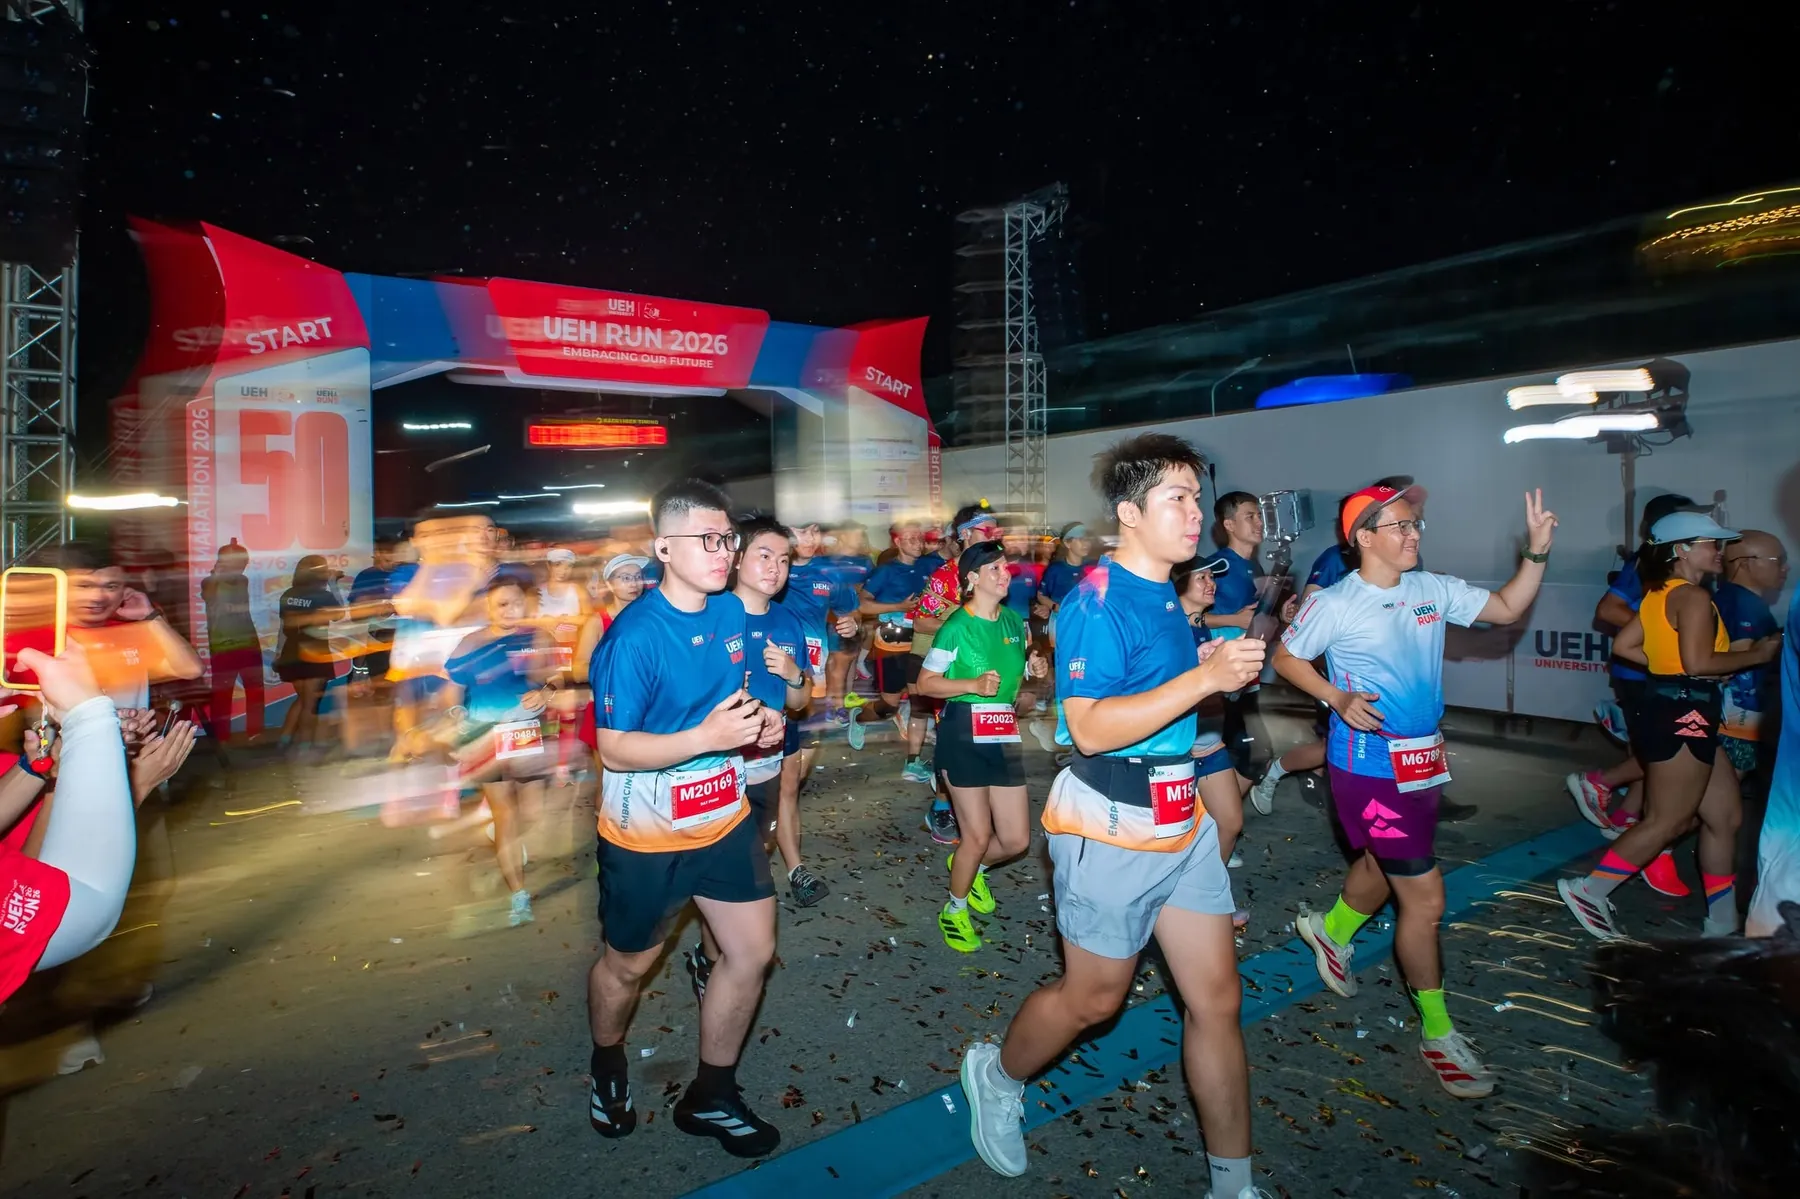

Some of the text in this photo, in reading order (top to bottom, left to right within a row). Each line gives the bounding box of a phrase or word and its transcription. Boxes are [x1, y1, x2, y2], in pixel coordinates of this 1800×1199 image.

[608, 298, 634, 312] UEH
[245, 316, 332, 354] START
[543, 315, 597, 344] UEH
[606, 322, 663, 349] RUN
[669, 329, 729, 356] 2026
[563, 346, 714, 369] EMBRACING OUR FUTURE
[240, 386, 269, 398] UEH
[864, 365, 913, 398] START
[192, 407, 210, 452] 2026
[239, 409, 349, 550] 50
[931, 445, 941, 504] FUTURE
[192, 455, 211, 563] MARATHON
[286, 596, 313, 608] CREW
[1412, 603, 1437, 617] UEH
[1417, 612, 1436, 626] RUN
[1535, 629, 1608, 662] UEH
[1535, 658, 1609, 673] UNIVERSITY
[979, 713, 1015, 725] F20023
[1401, 748, 1440, 767] M6789
[679, 773, 733, 802] M20169
[3, 891, 24, 930] UEH
[13, 898, 41, 935] RUN
